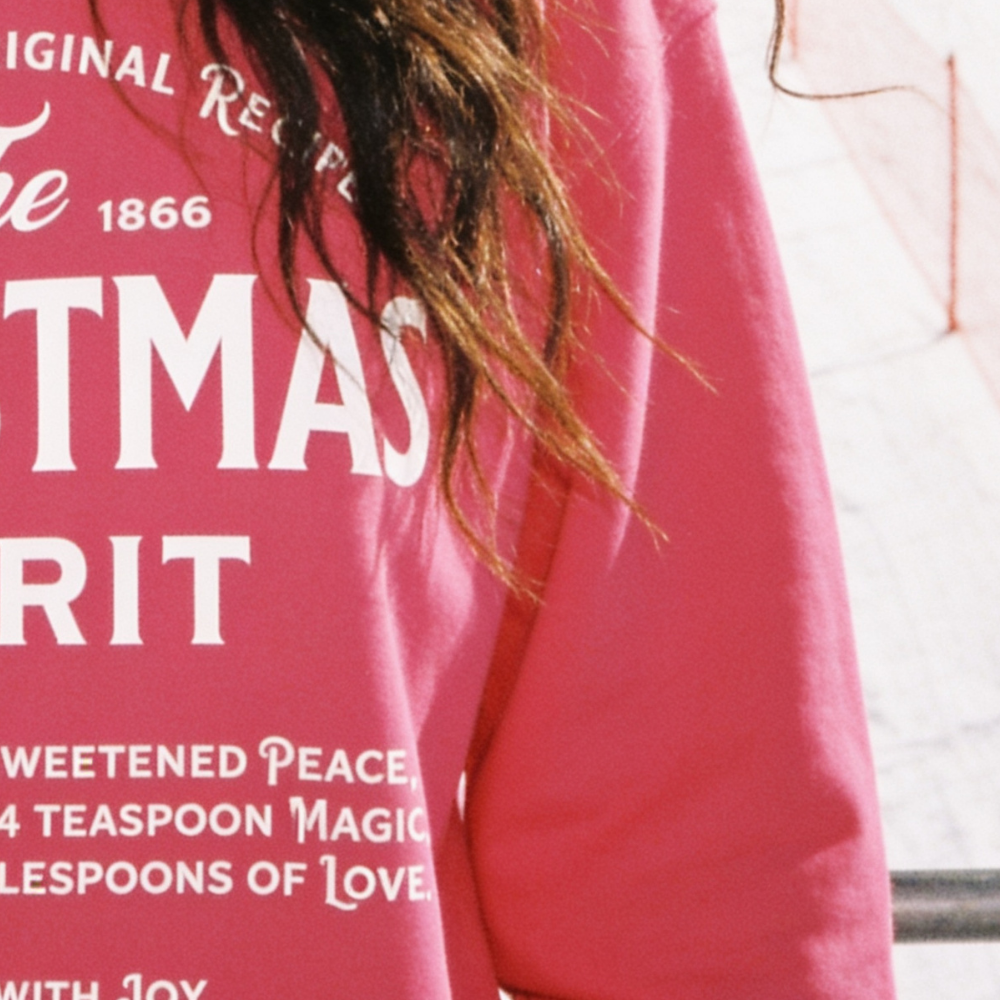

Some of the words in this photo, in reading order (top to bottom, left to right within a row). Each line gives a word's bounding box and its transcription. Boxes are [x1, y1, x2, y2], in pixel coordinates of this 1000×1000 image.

[98, 195, 211, 232] 1866
[258, 735, 418, 792] PEACE,
[33, 803, 272, 837] TEASPOON
[247, 861, 307, 896] OF
